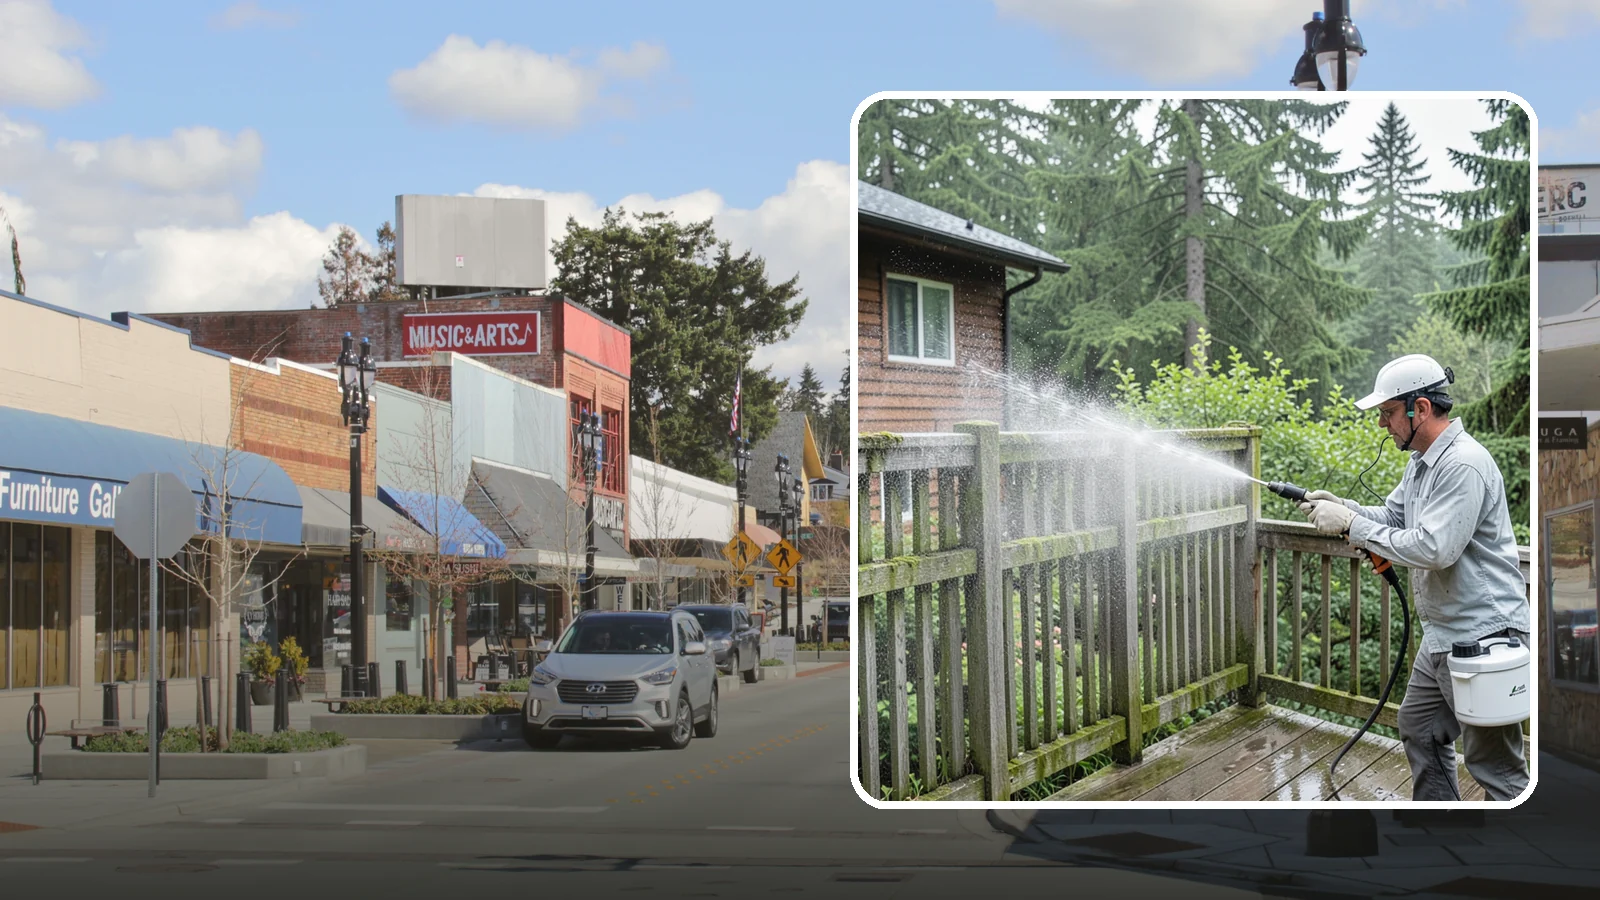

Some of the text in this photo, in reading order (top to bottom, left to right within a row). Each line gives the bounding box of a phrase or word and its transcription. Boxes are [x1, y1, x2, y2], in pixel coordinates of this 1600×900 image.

[0, 471, 122, 519] Furniture Gal
[453, 563, 480, 574] SUSHI
